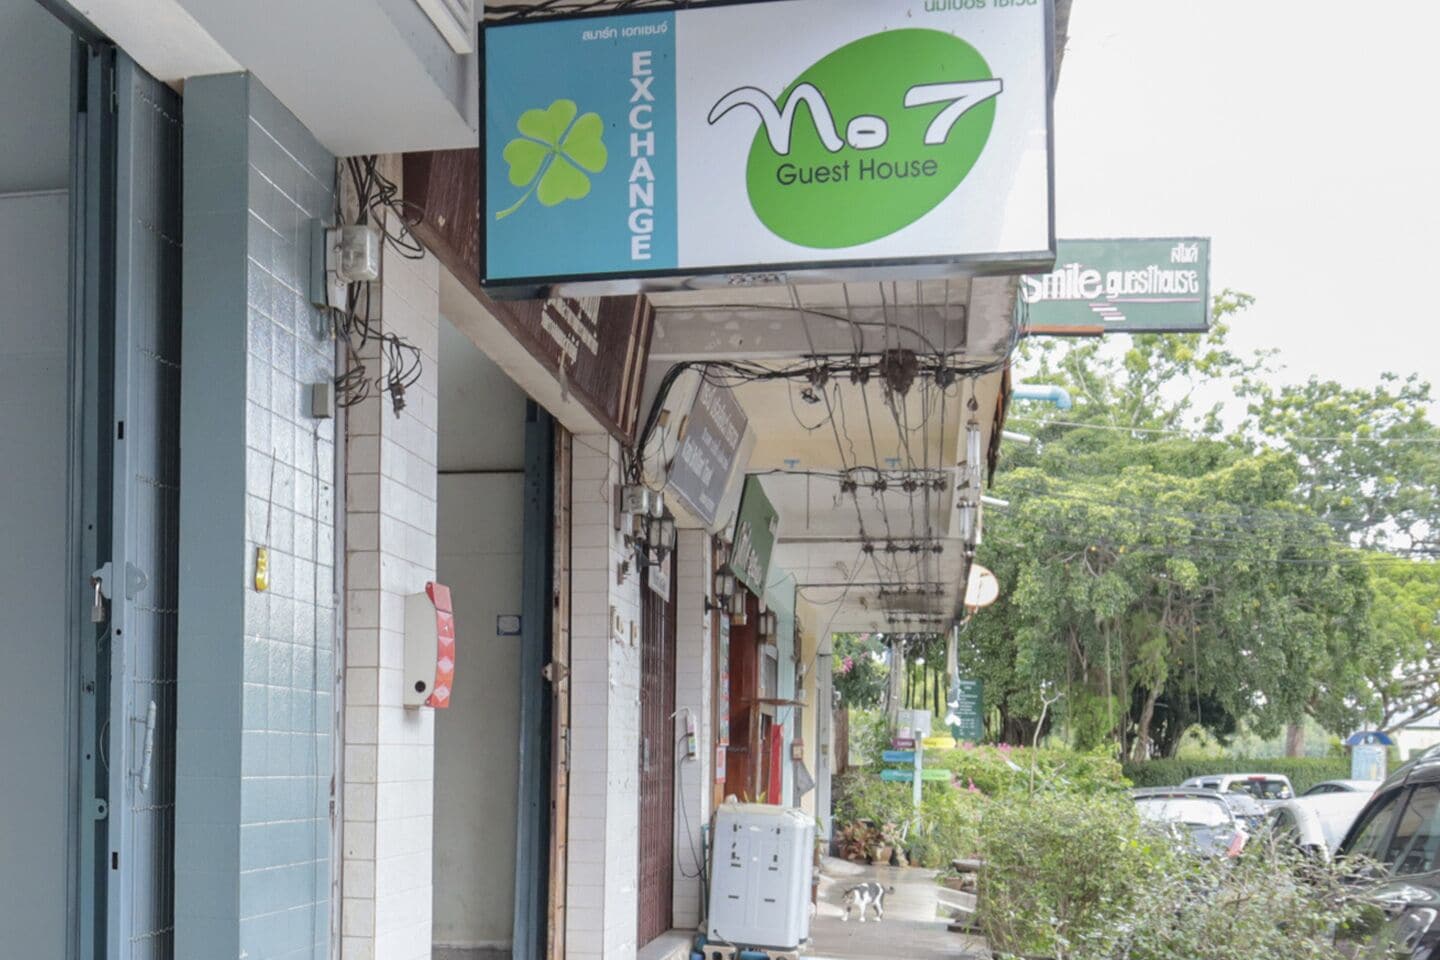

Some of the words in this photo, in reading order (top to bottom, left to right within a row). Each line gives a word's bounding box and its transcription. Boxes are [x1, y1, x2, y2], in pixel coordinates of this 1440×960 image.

[903, 77, 1004, 146] 7
[628, 50, 655, 261] EXCHANGE
[776, 160, 851, 186] Guest
[859, 157, 939, 182] House
[1106, 264, 1200, 299] guesthouse
